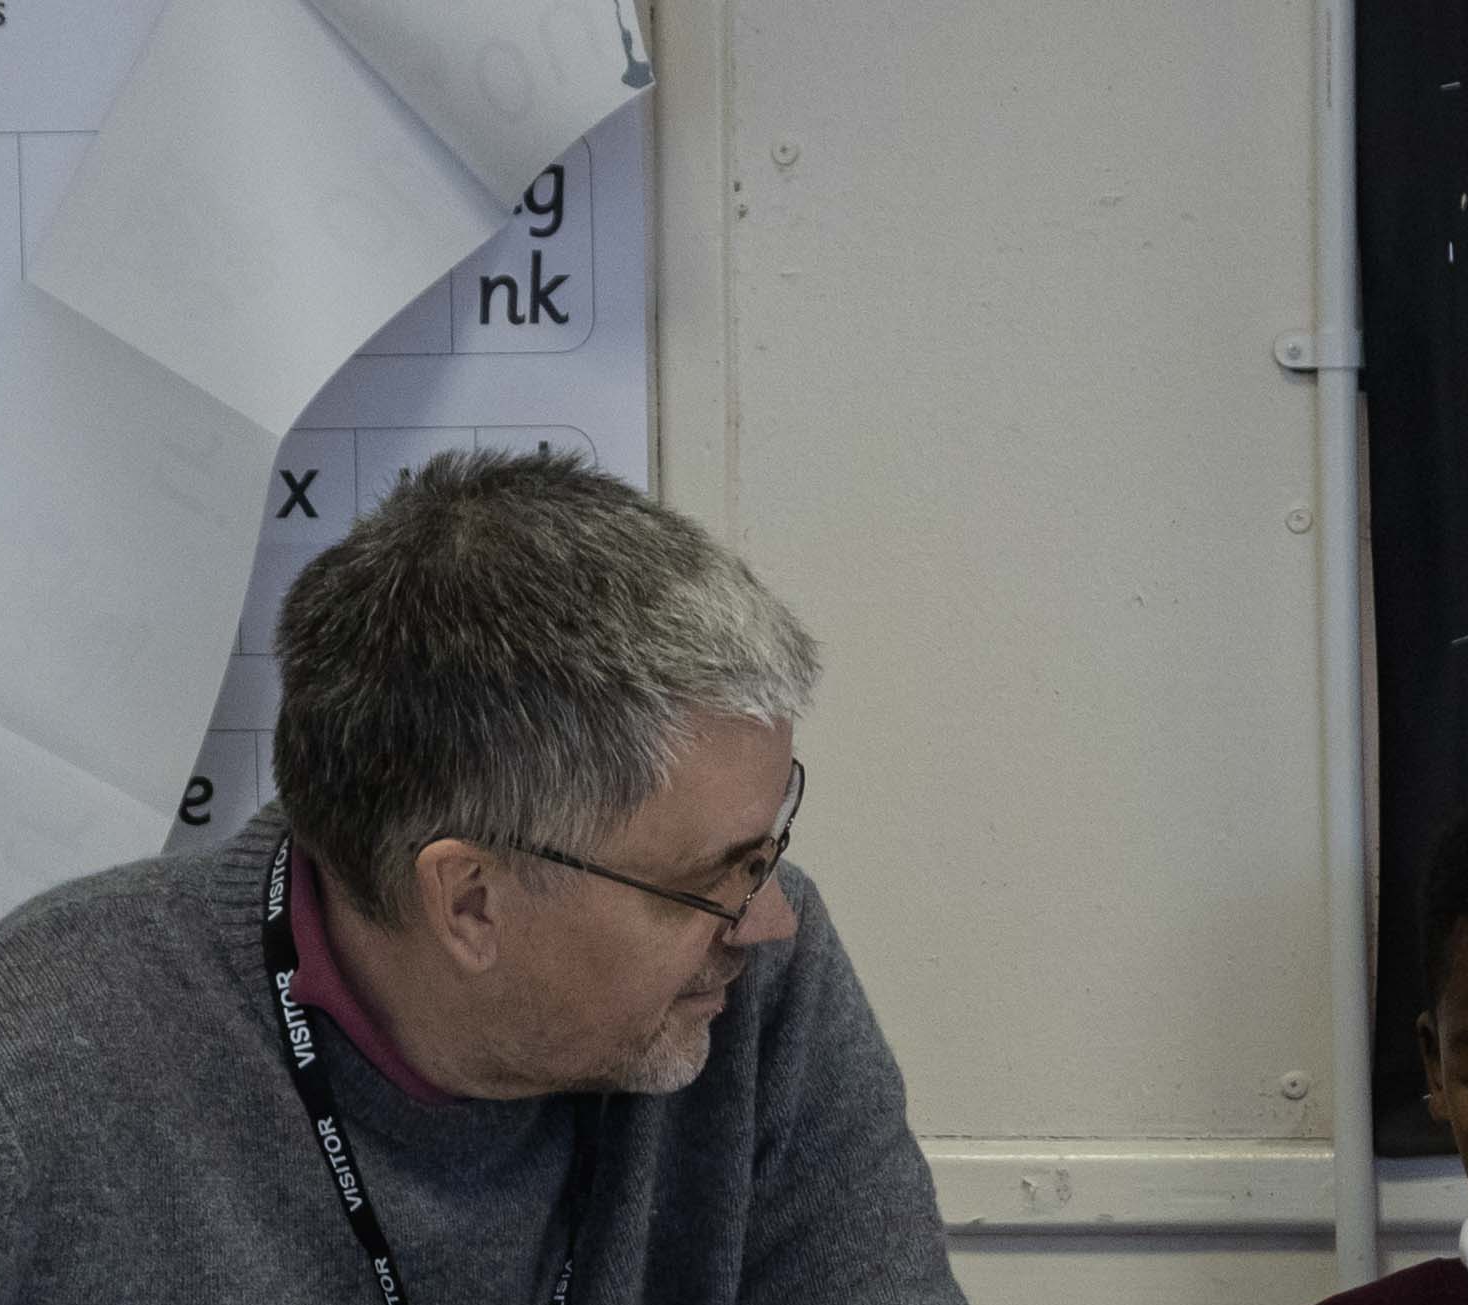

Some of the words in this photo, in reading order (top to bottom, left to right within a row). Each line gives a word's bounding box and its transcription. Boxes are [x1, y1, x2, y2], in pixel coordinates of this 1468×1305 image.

[479, 249, 570, 326] nk
[275, 469, 320, 519] x
[275, 968, 317, 1070] VISITOR
[317, 1115, 363, 1213] VISITOR
